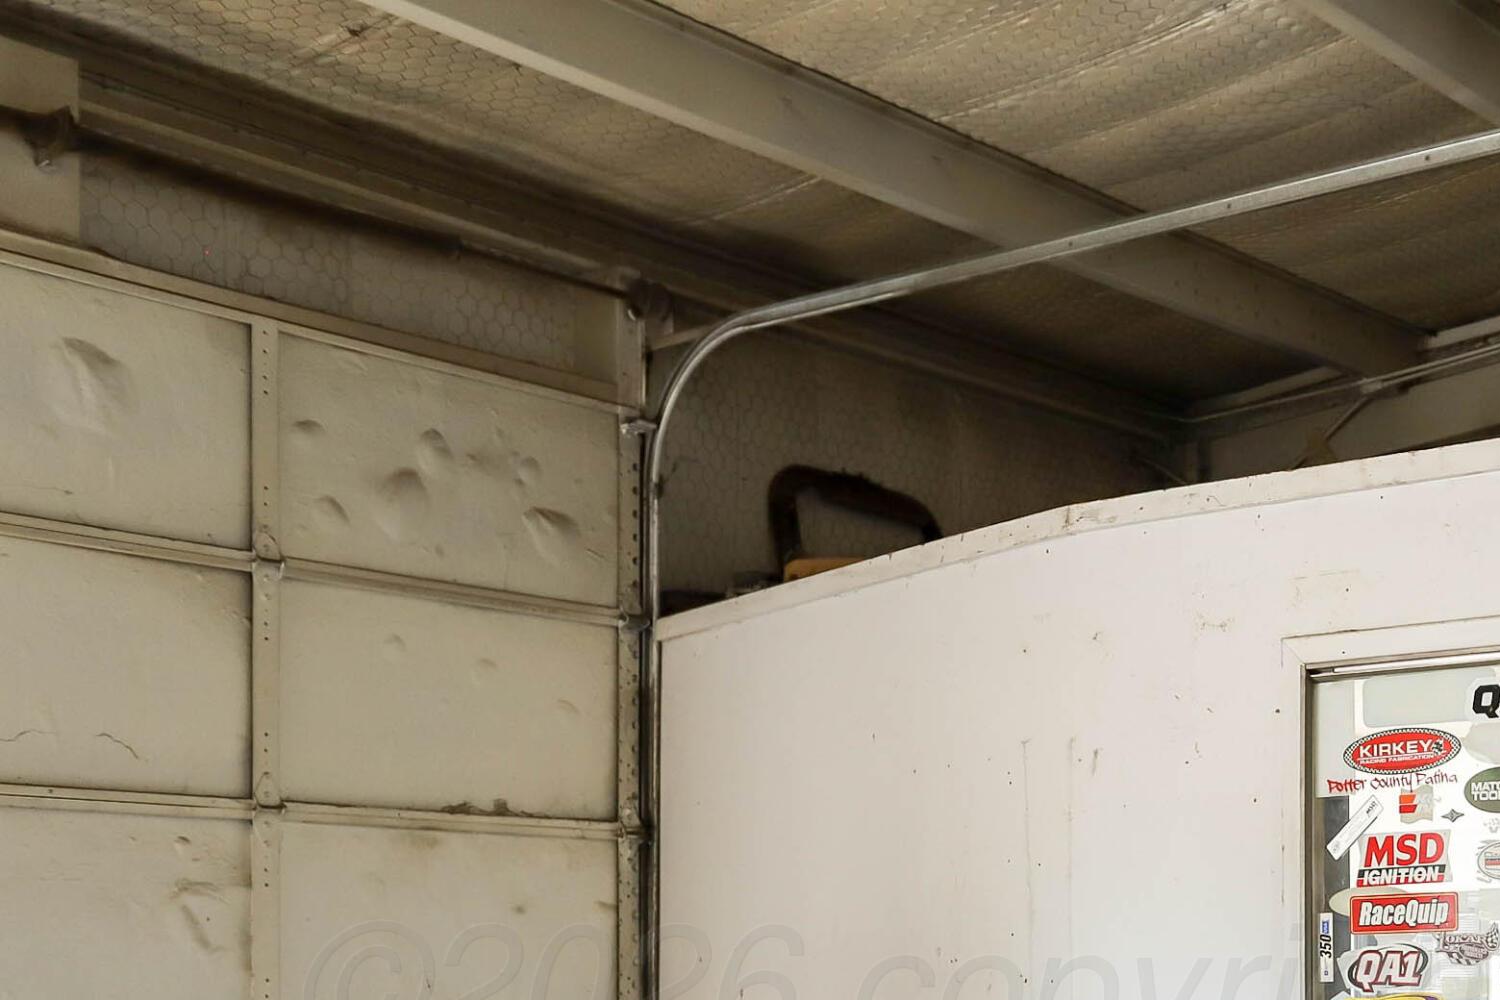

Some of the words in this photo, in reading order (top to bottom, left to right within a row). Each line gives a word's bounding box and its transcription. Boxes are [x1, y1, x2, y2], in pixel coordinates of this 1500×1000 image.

[1359, 739, 1433, 758] KIRKEY
[1388, 754, 1434, 763] FABRICATION
[1363, 832, 1445, 868] MSD
[1363, 867, 1440, 886] IGNITION
[1359, 899, 1449, 929] RaceQuip
[1319, 934, 1332, 959] 350
[1356, 950, 1422, 993] QA1
